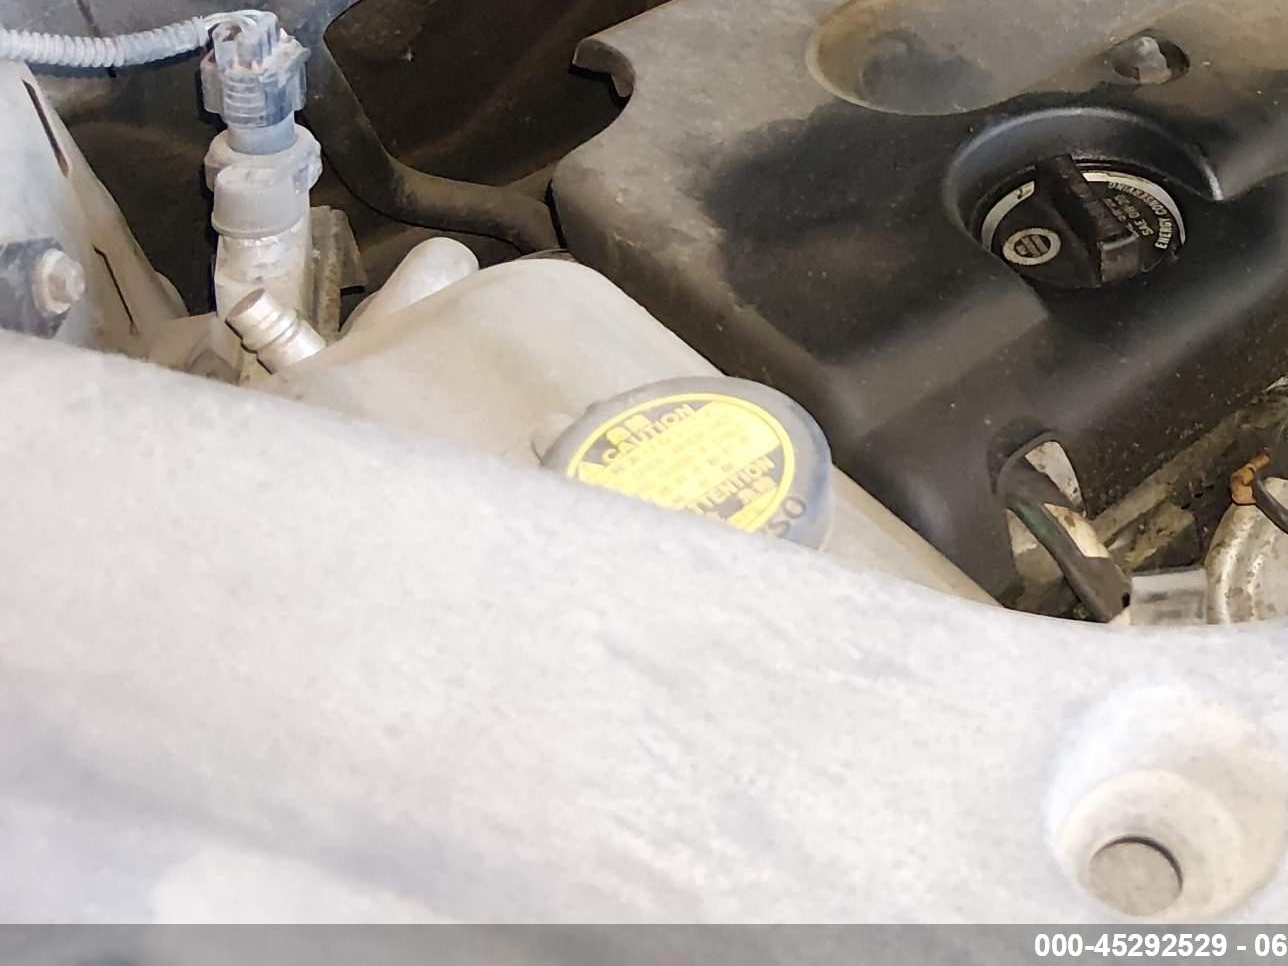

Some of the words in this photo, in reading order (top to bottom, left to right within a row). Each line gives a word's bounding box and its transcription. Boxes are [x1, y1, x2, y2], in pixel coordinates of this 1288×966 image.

[1154, 217, 1173, 250] ENERGY
[601, 403, 696, 465] CAUTION
[694, 455, 776, 516] TTENTION
